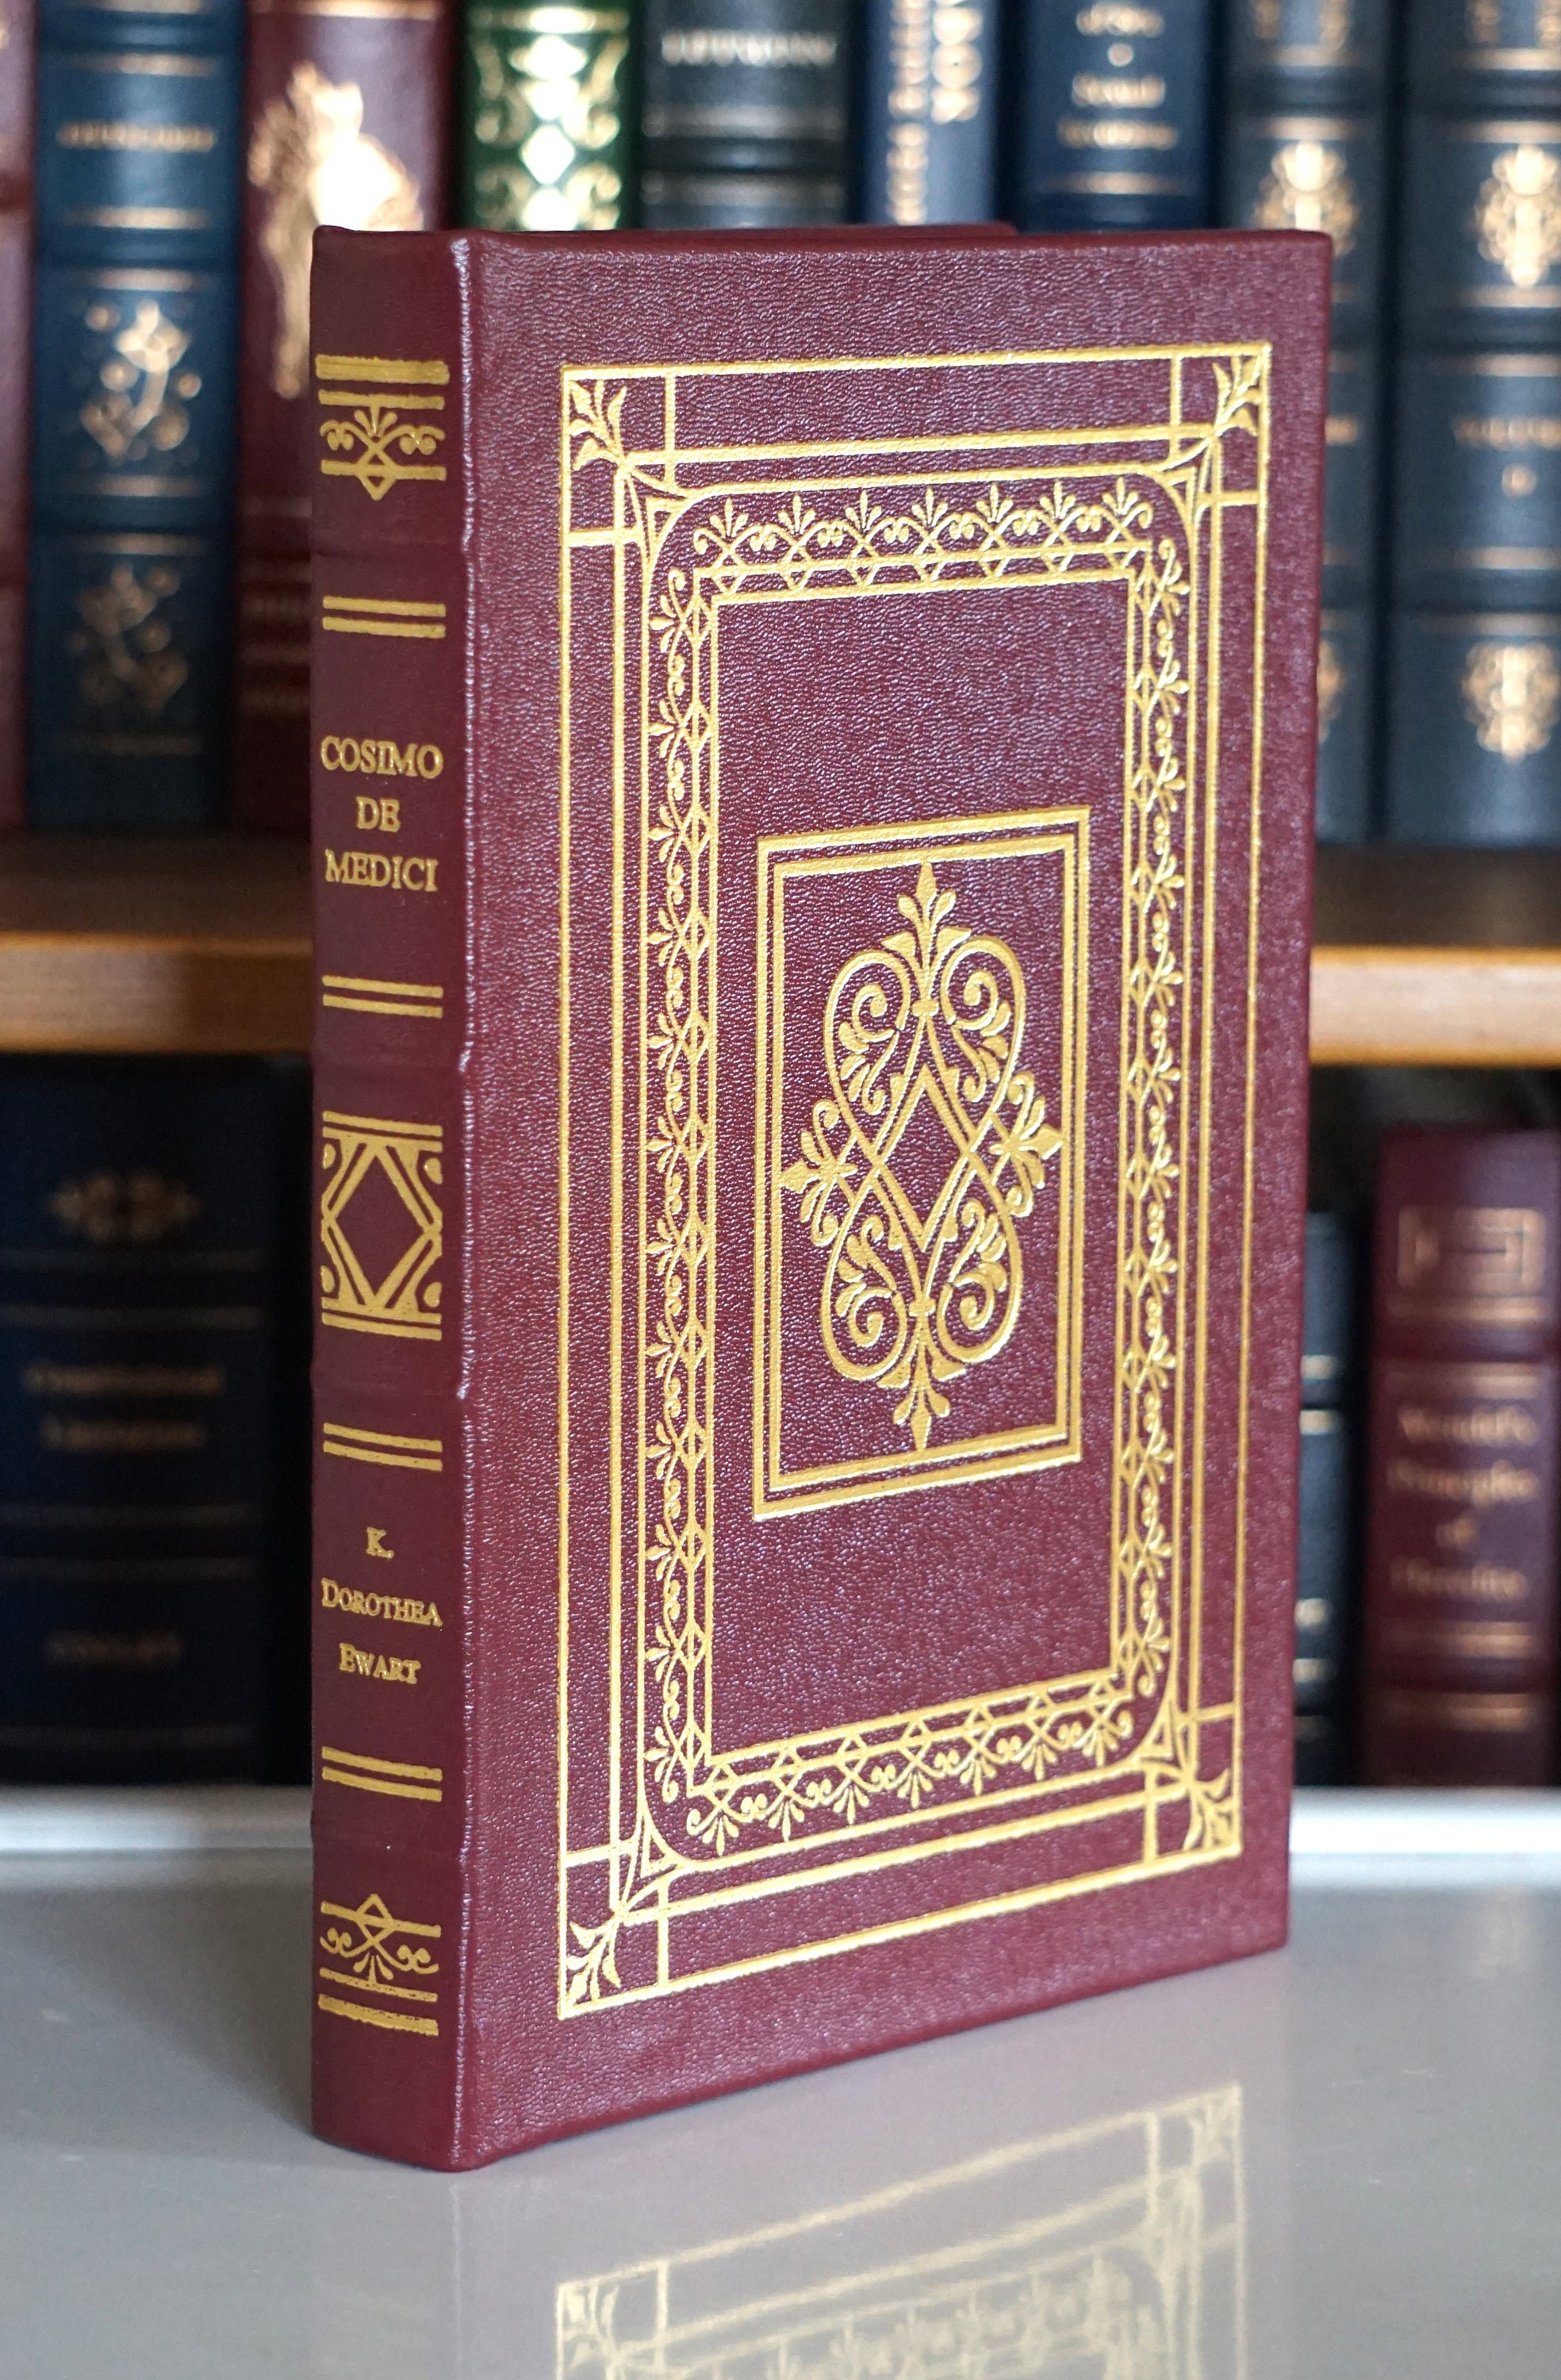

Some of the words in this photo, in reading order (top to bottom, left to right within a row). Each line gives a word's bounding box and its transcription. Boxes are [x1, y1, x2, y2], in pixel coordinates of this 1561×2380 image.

[320, 735, 444, 779] COSIMO
[324, 848, 439, 892] MEDICI
[366, 1526, 394, 1560] K.
[320, 1577, 443, 1627] DOROTHEA
[339, 1642, 421, 1684] EWART
